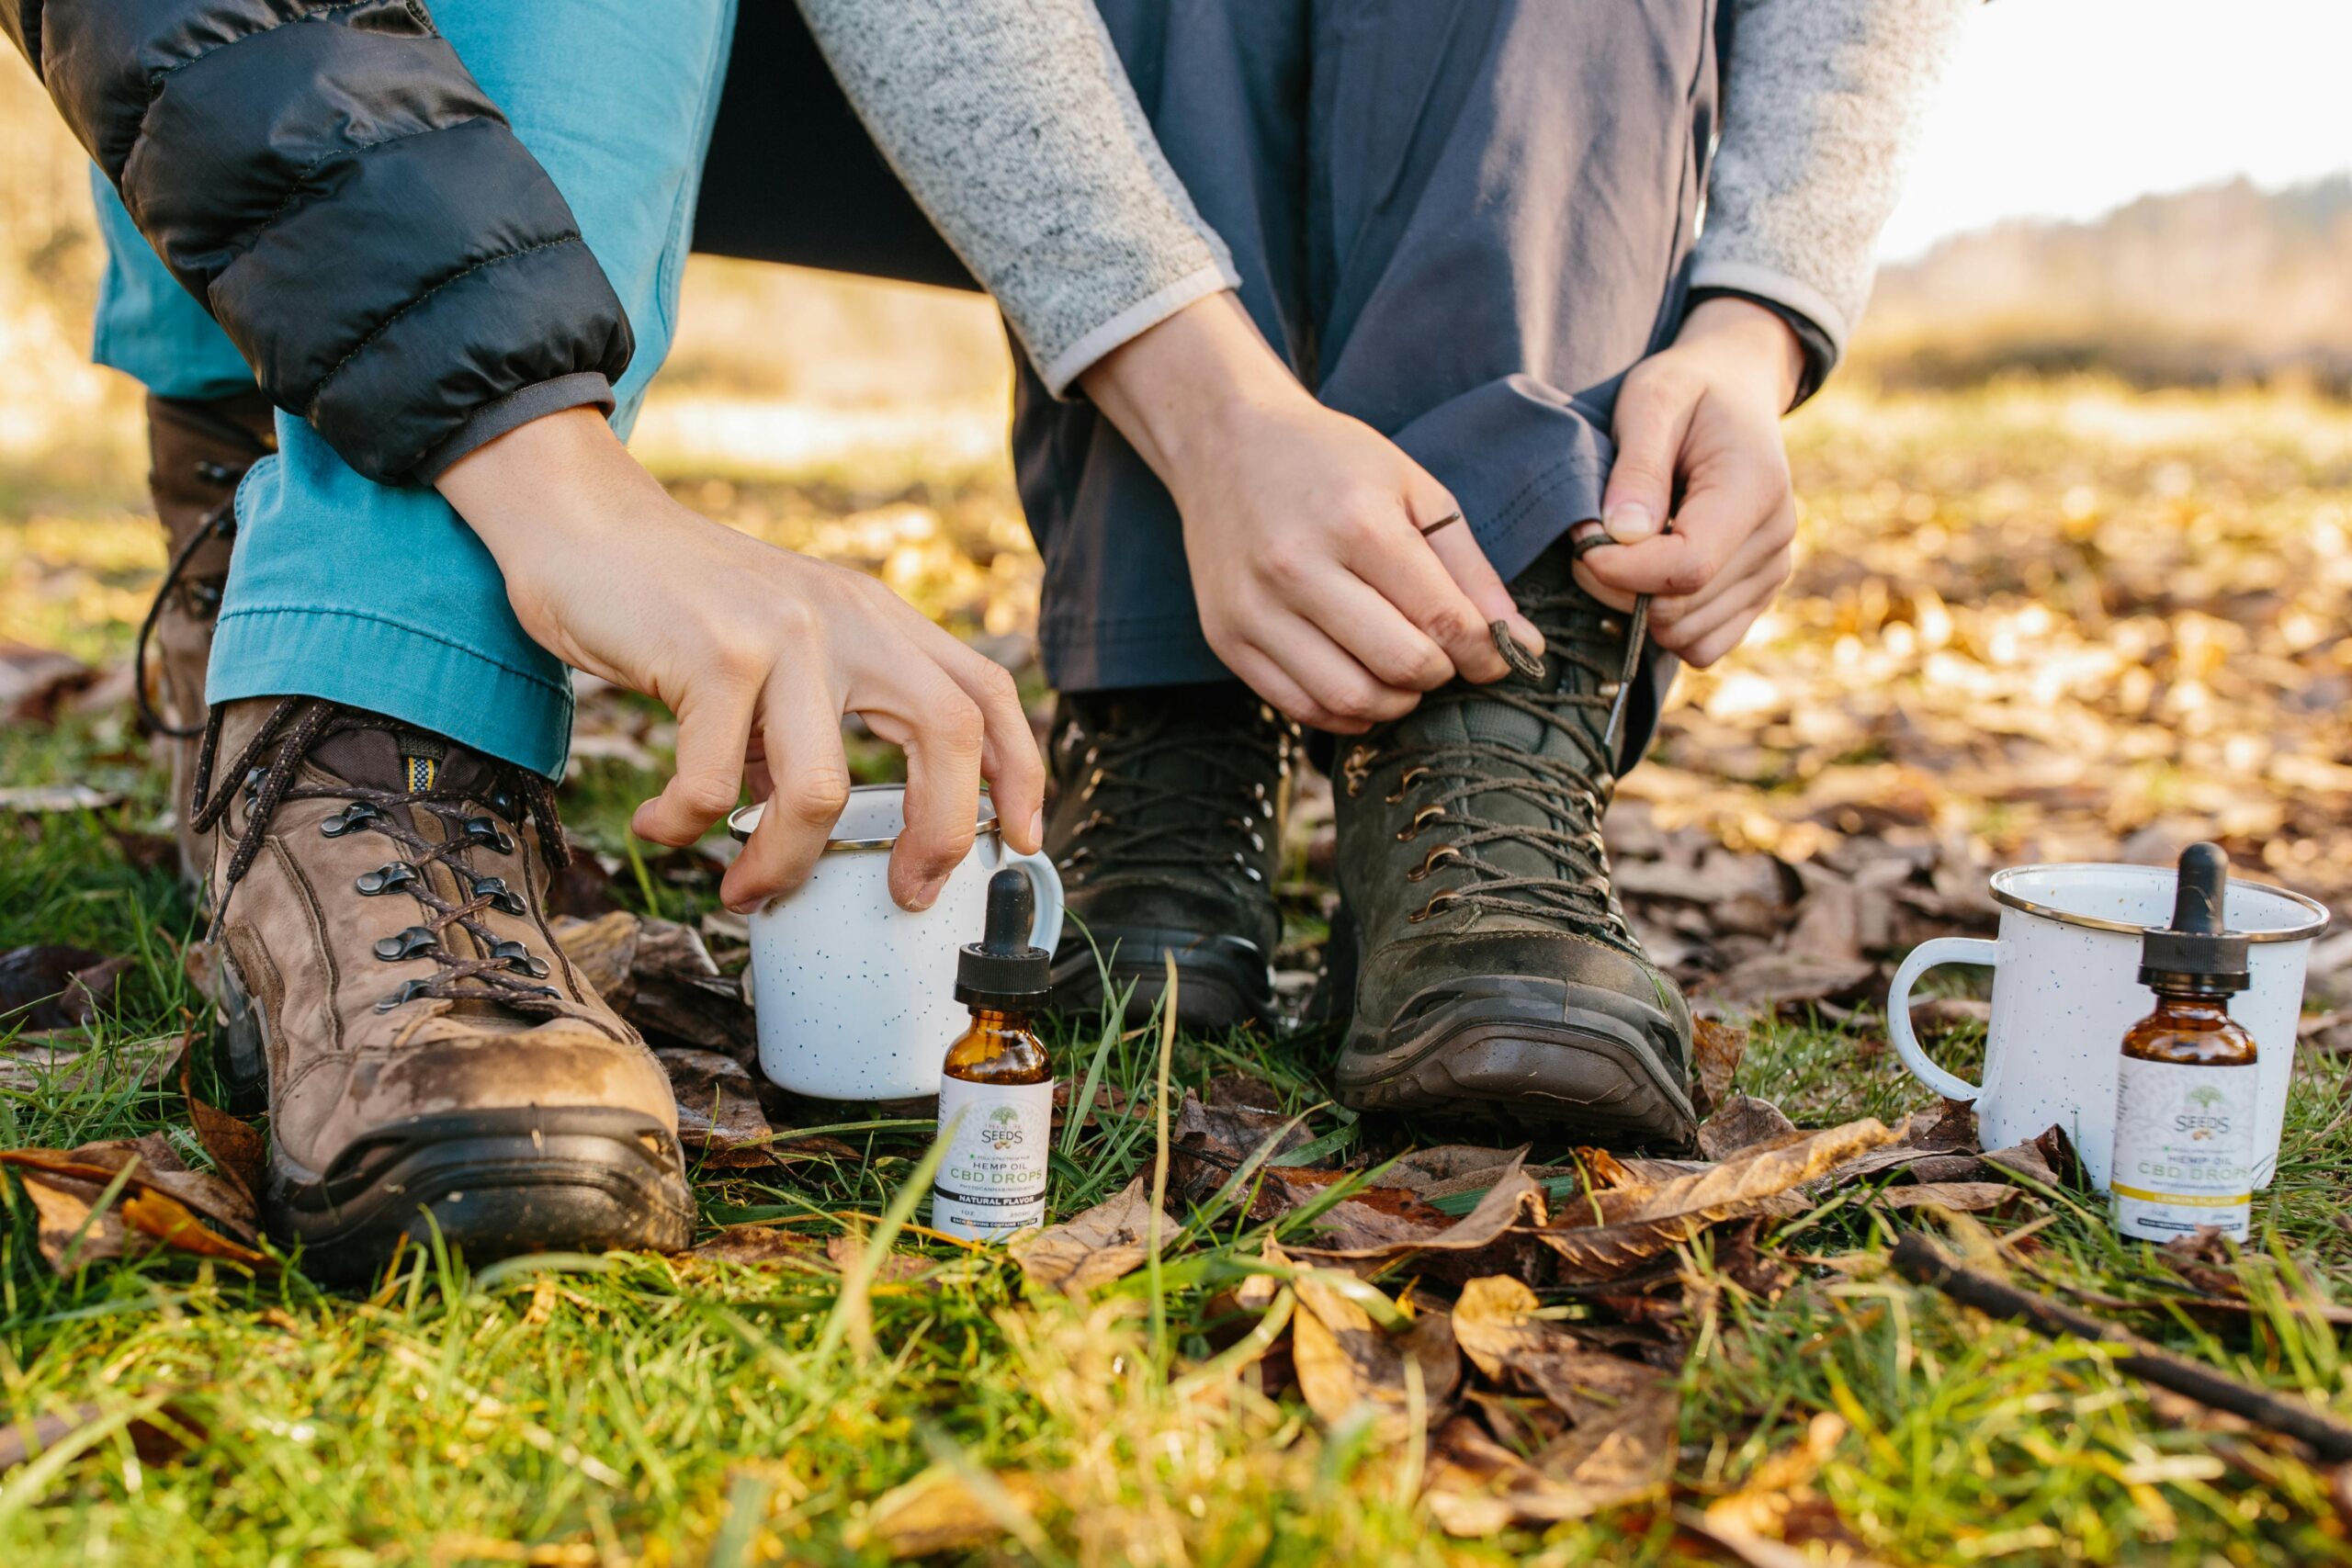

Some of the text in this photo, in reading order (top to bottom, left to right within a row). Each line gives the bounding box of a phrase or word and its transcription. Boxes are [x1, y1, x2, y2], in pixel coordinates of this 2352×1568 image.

[2175, 1115, 2231, 1134] SEEDS
[981, 1130, 1023, 1144] SEEDS
[973, 1161, 1028, 1171] HEMP OIL
[2213, 1156, 2233, 1165] OIL
[950, 1168, 1043, 1184] CBD DROPS
[2137, 1162, 2181, 1179] CBD
[2189, 1166, 2249, 1182] DROPS
[959, 1195, 1035, 1206] NATURAL FLAVOR
